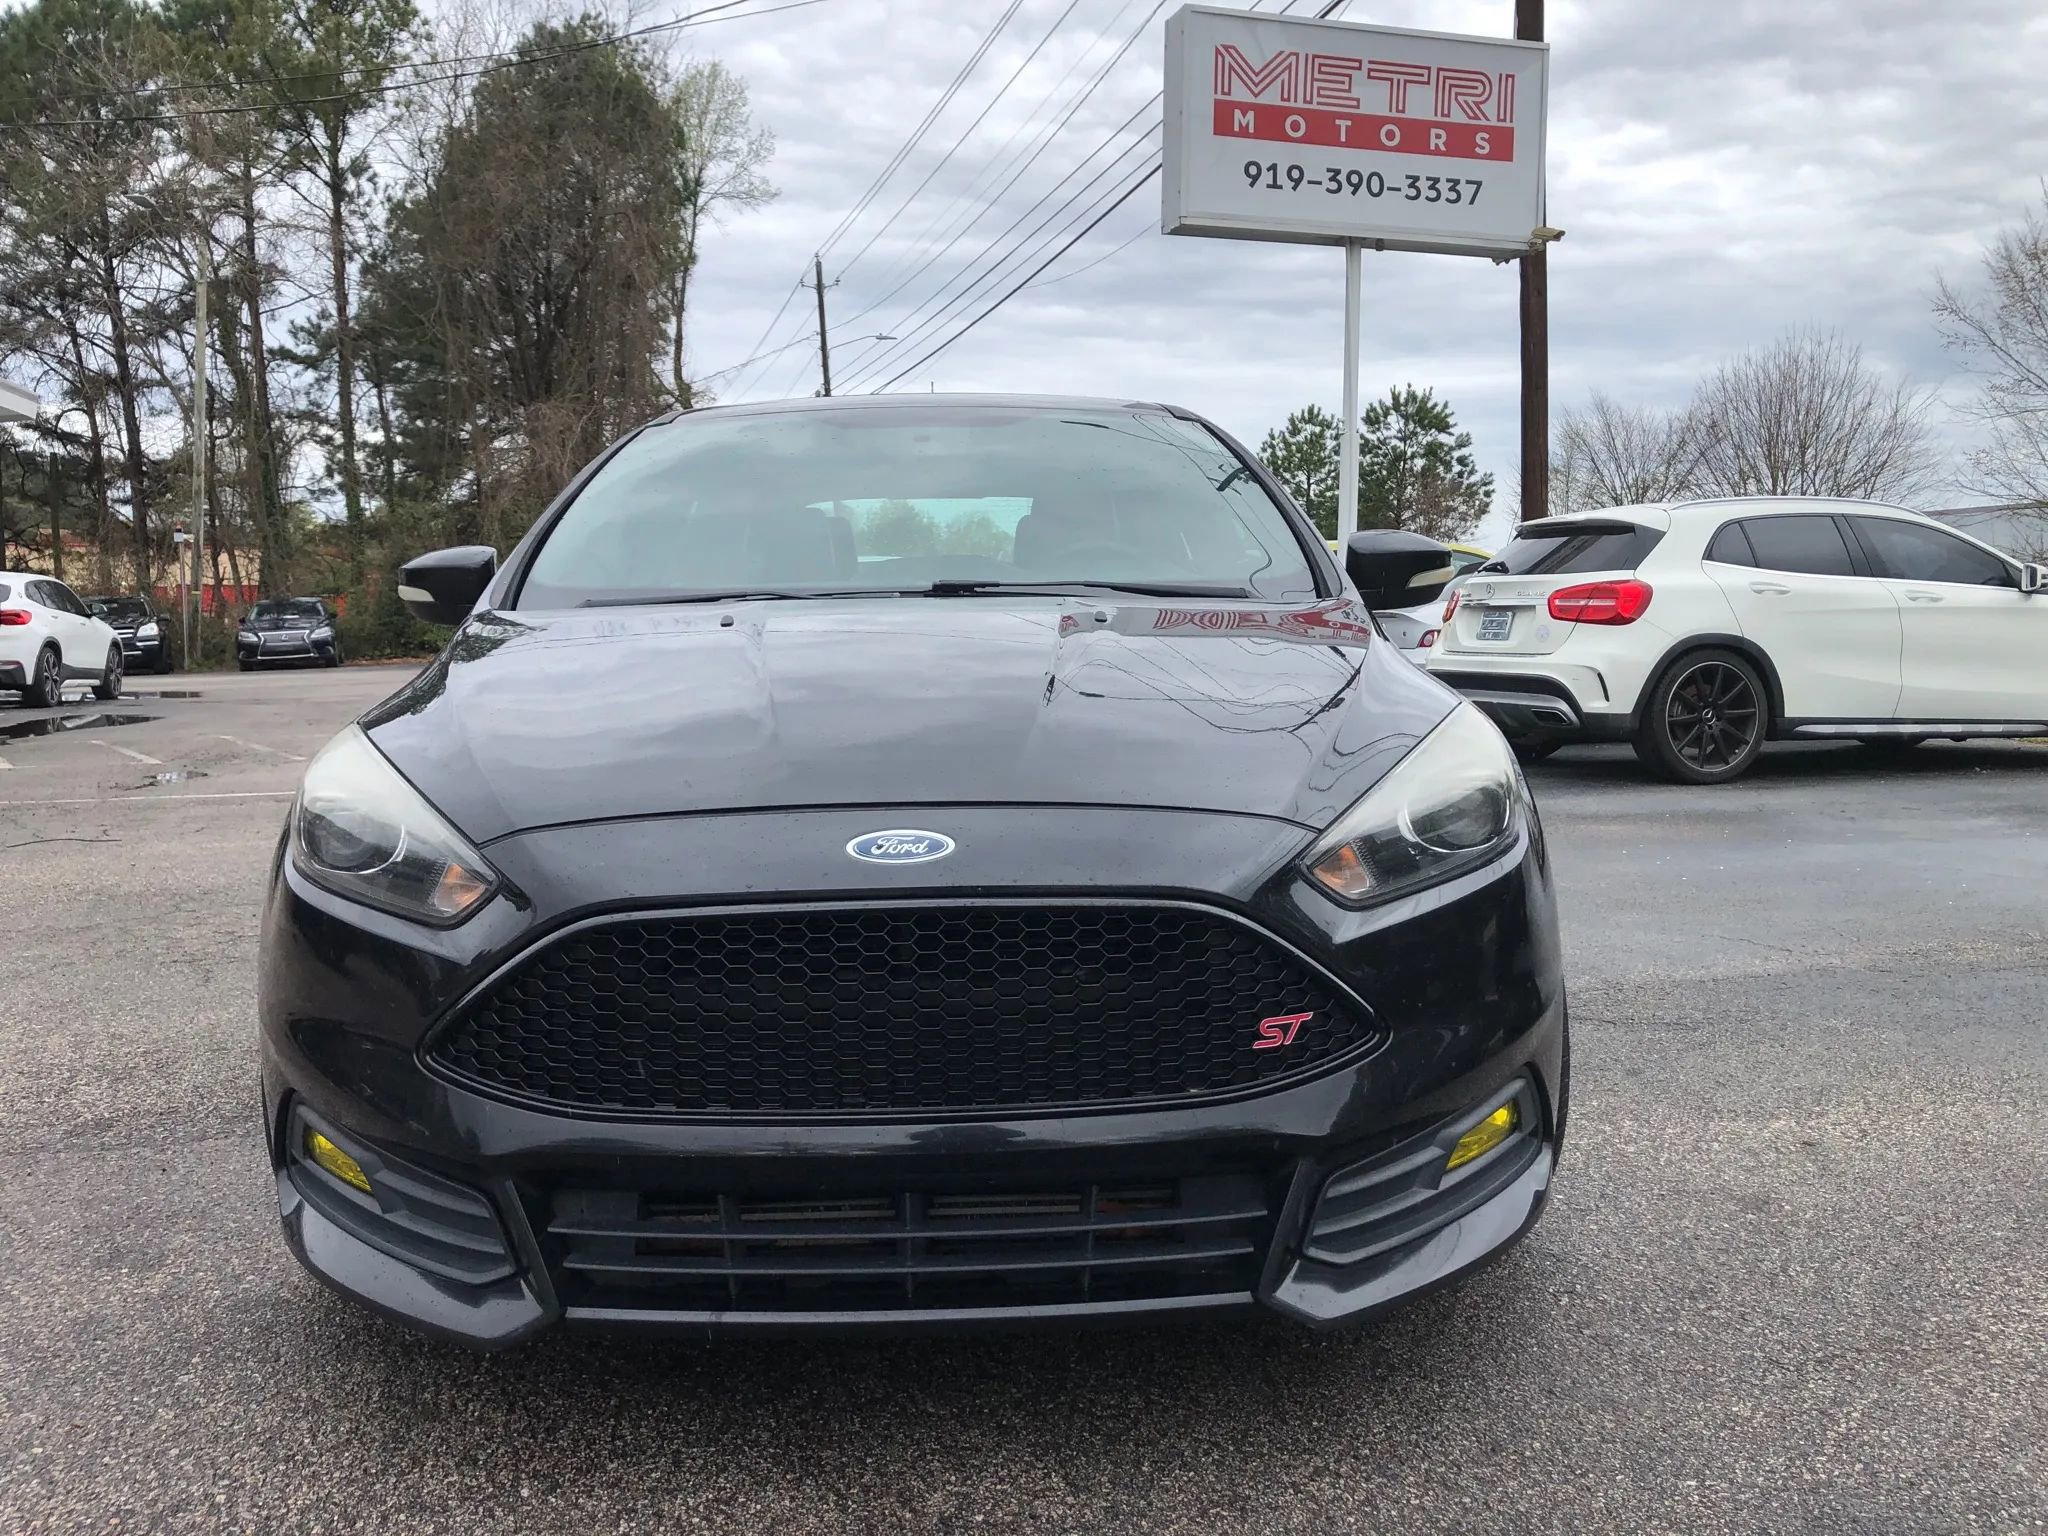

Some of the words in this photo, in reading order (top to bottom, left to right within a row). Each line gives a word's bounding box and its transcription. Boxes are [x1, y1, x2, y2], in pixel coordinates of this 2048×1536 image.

[1213, 43, 1516, 123] METRI
[1233, 109, 1491, 155] MOTORS
[1244, 160, 1483, 206] 919-390-3337
[870, 835, 930, 855] Ford
[1252, 1011, 1314, 1049] ST
